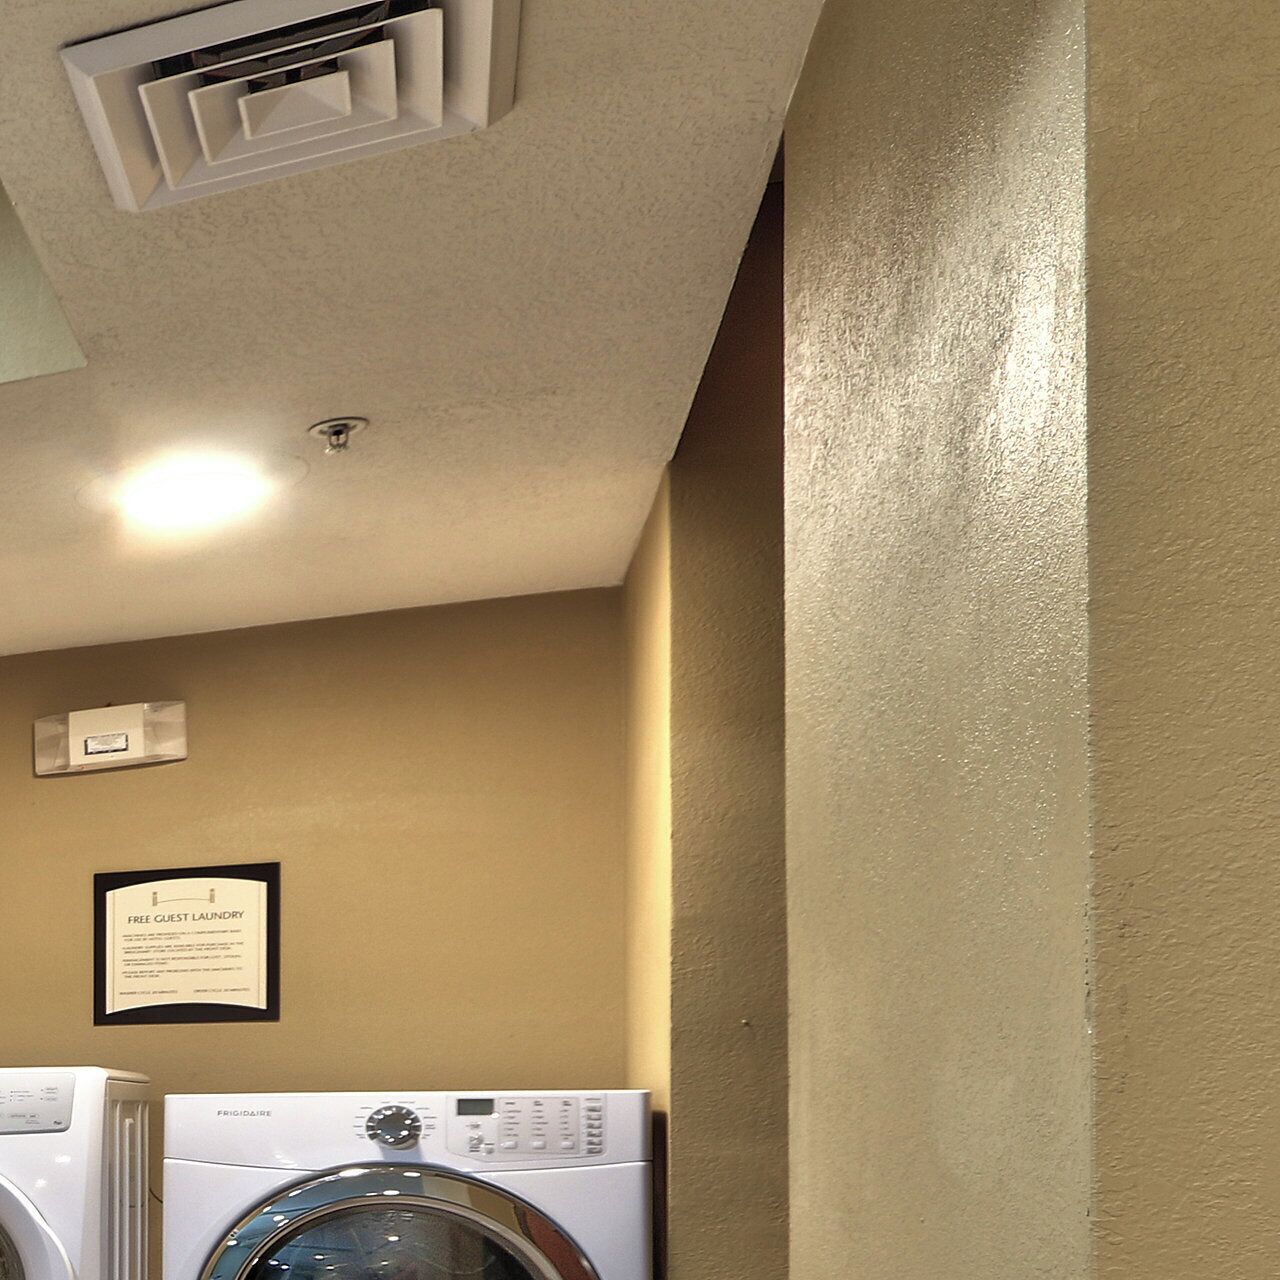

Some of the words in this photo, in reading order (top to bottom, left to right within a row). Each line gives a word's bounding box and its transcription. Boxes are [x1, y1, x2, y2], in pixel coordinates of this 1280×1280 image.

[128, 915, 151, 924] FREE
[154, 914, 188, 922] GUEST
[192, 910, 244, 922] LAUNDRY
